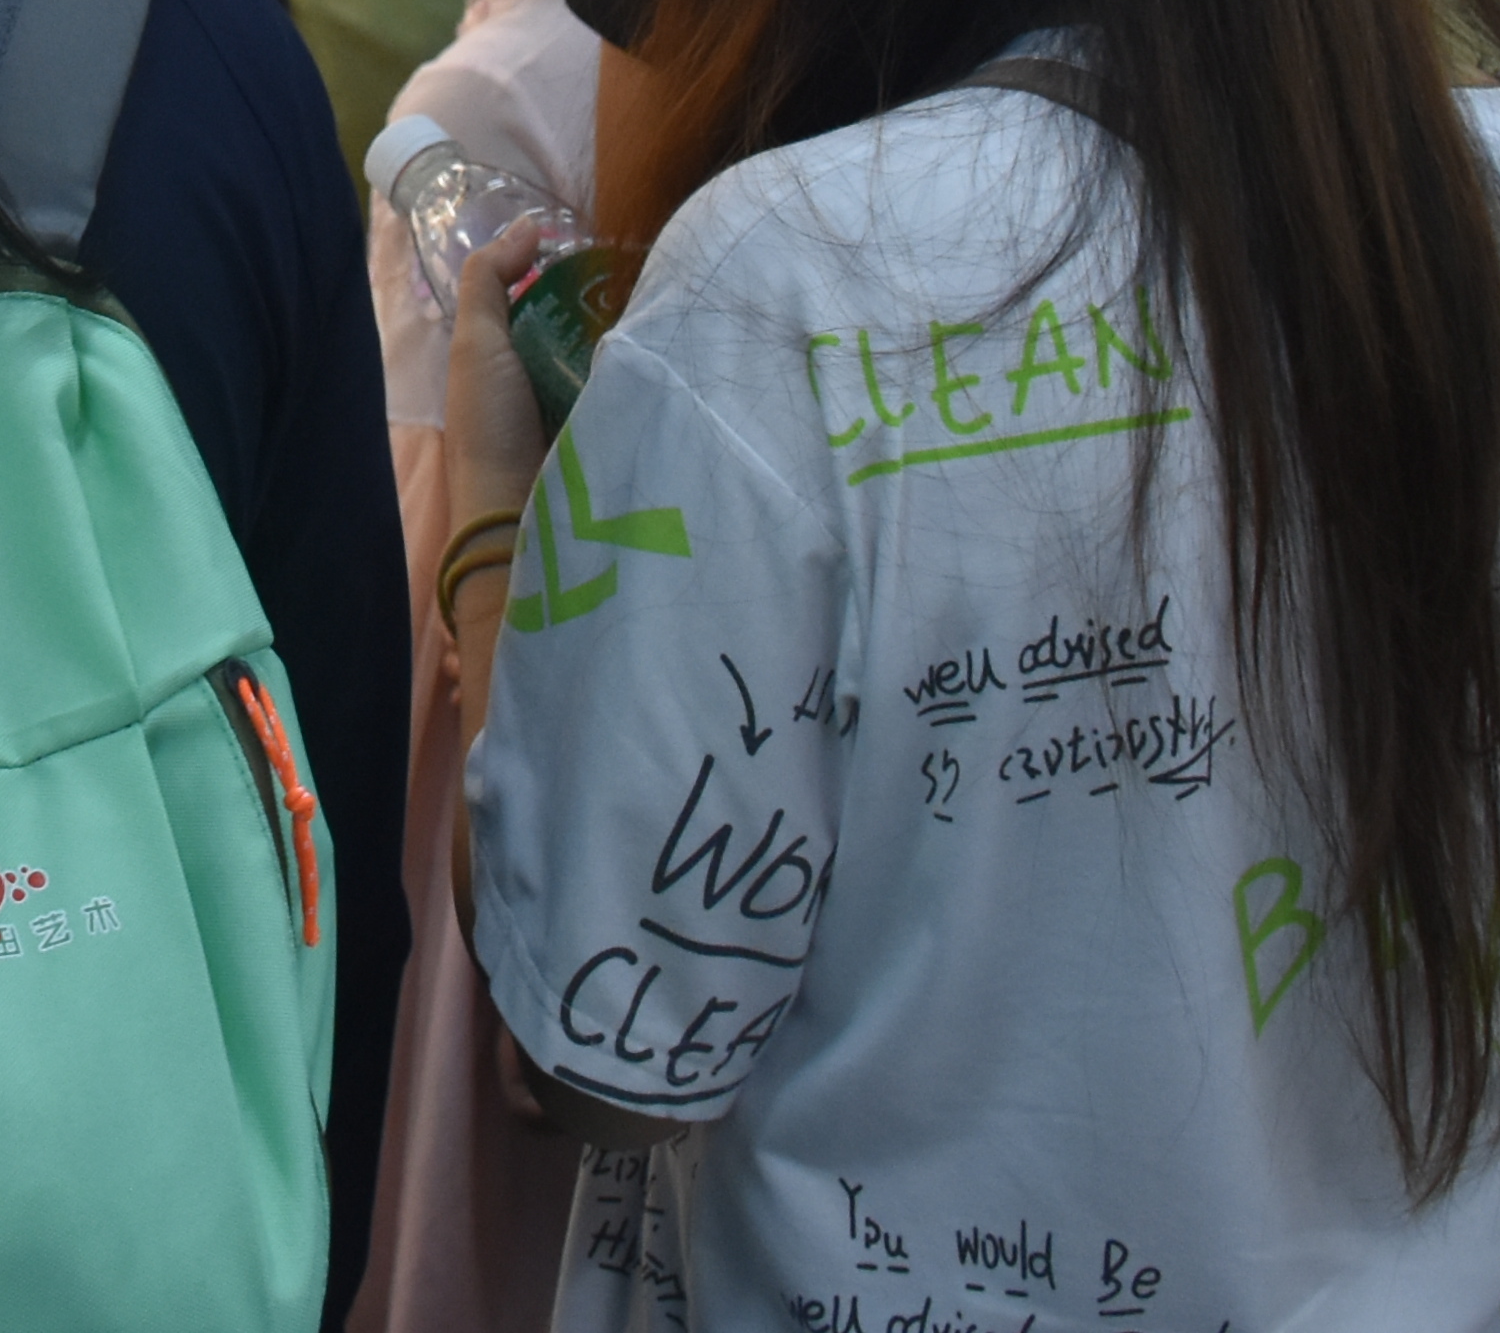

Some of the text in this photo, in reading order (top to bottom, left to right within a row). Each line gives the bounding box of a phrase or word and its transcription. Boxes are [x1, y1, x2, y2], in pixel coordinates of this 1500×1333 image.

[808, 286, 1174, 448] CLEAN
[904, 647, 1007, 705] well
[651, 753, 839, 925] WO
[955, 1219, 1056, 1291] would
